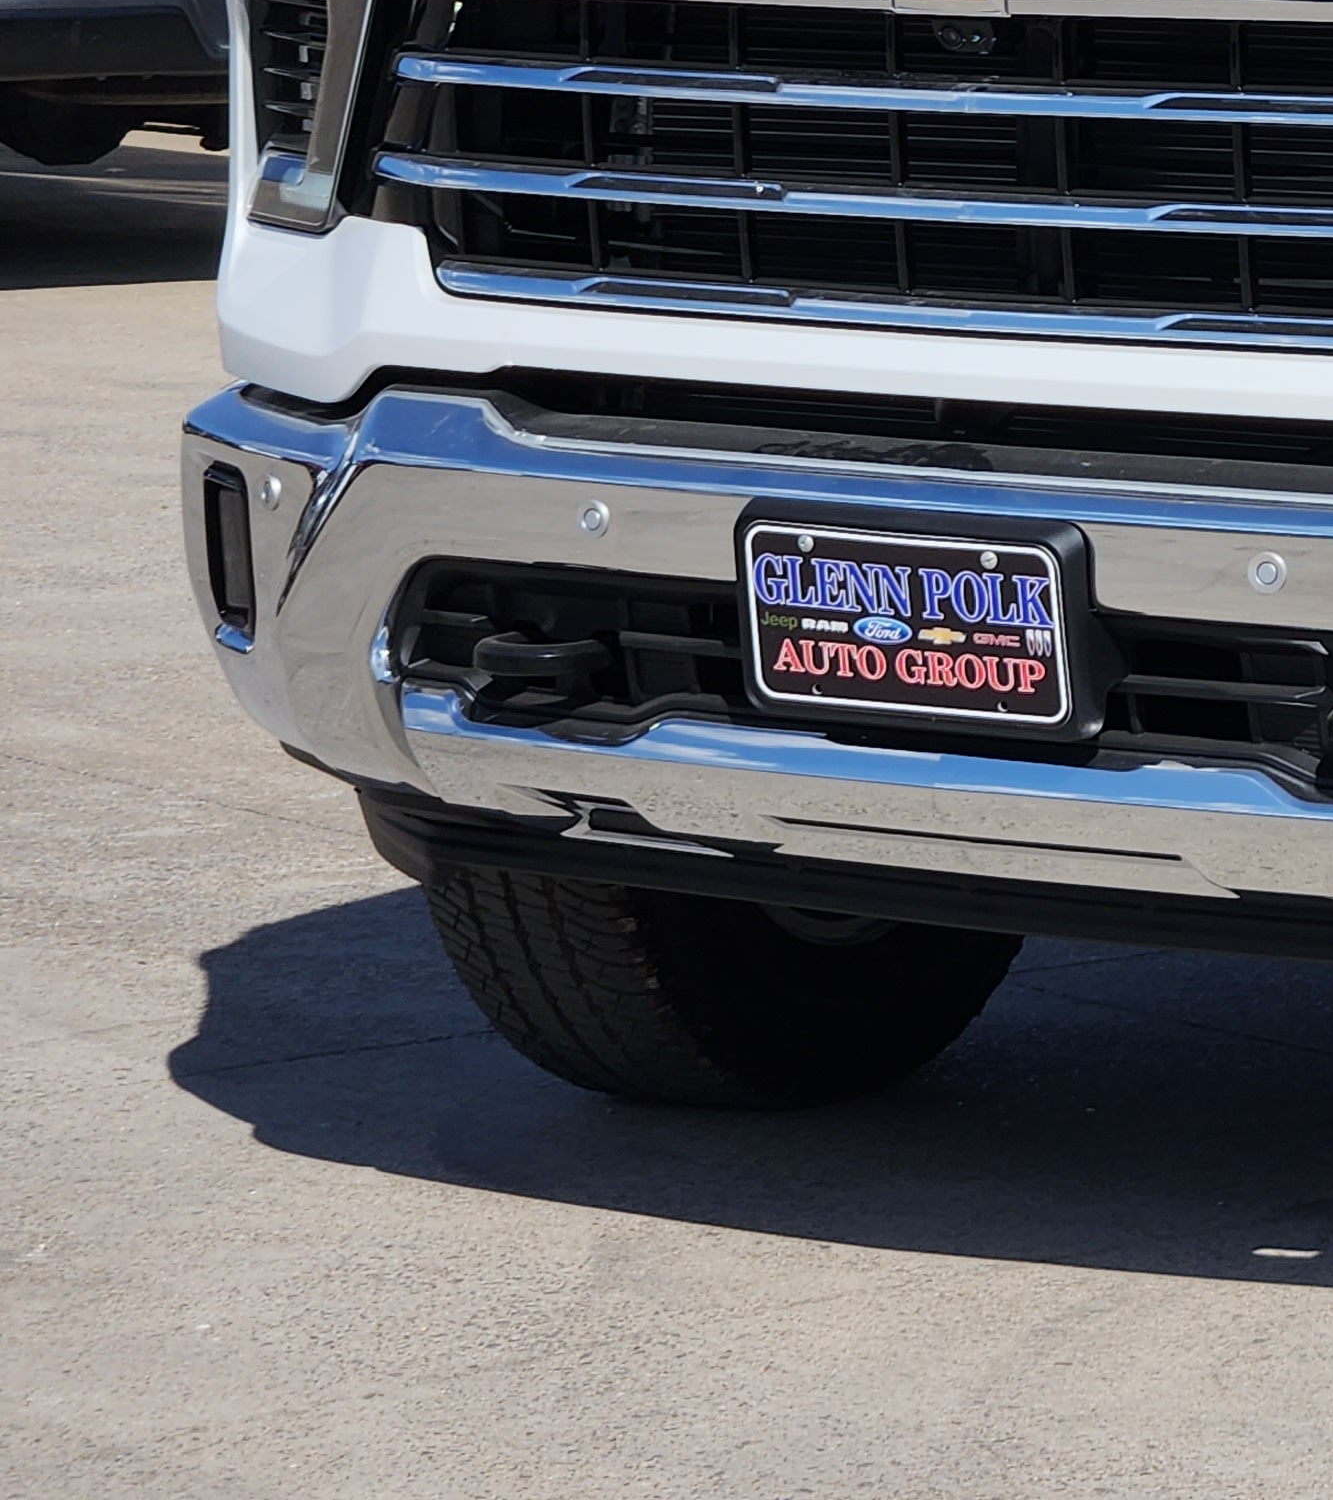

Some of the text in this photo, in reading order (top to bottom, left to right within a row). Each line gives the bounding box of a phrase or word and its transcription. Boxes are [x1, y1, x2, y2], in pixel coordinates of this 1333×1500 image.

[752, 551, 1055, 629] GLENN POLK
[761, 611, 1021, 648] Jeep RAM Ford GMC
[773, 637, 1047, 695] AUTO GROUP
